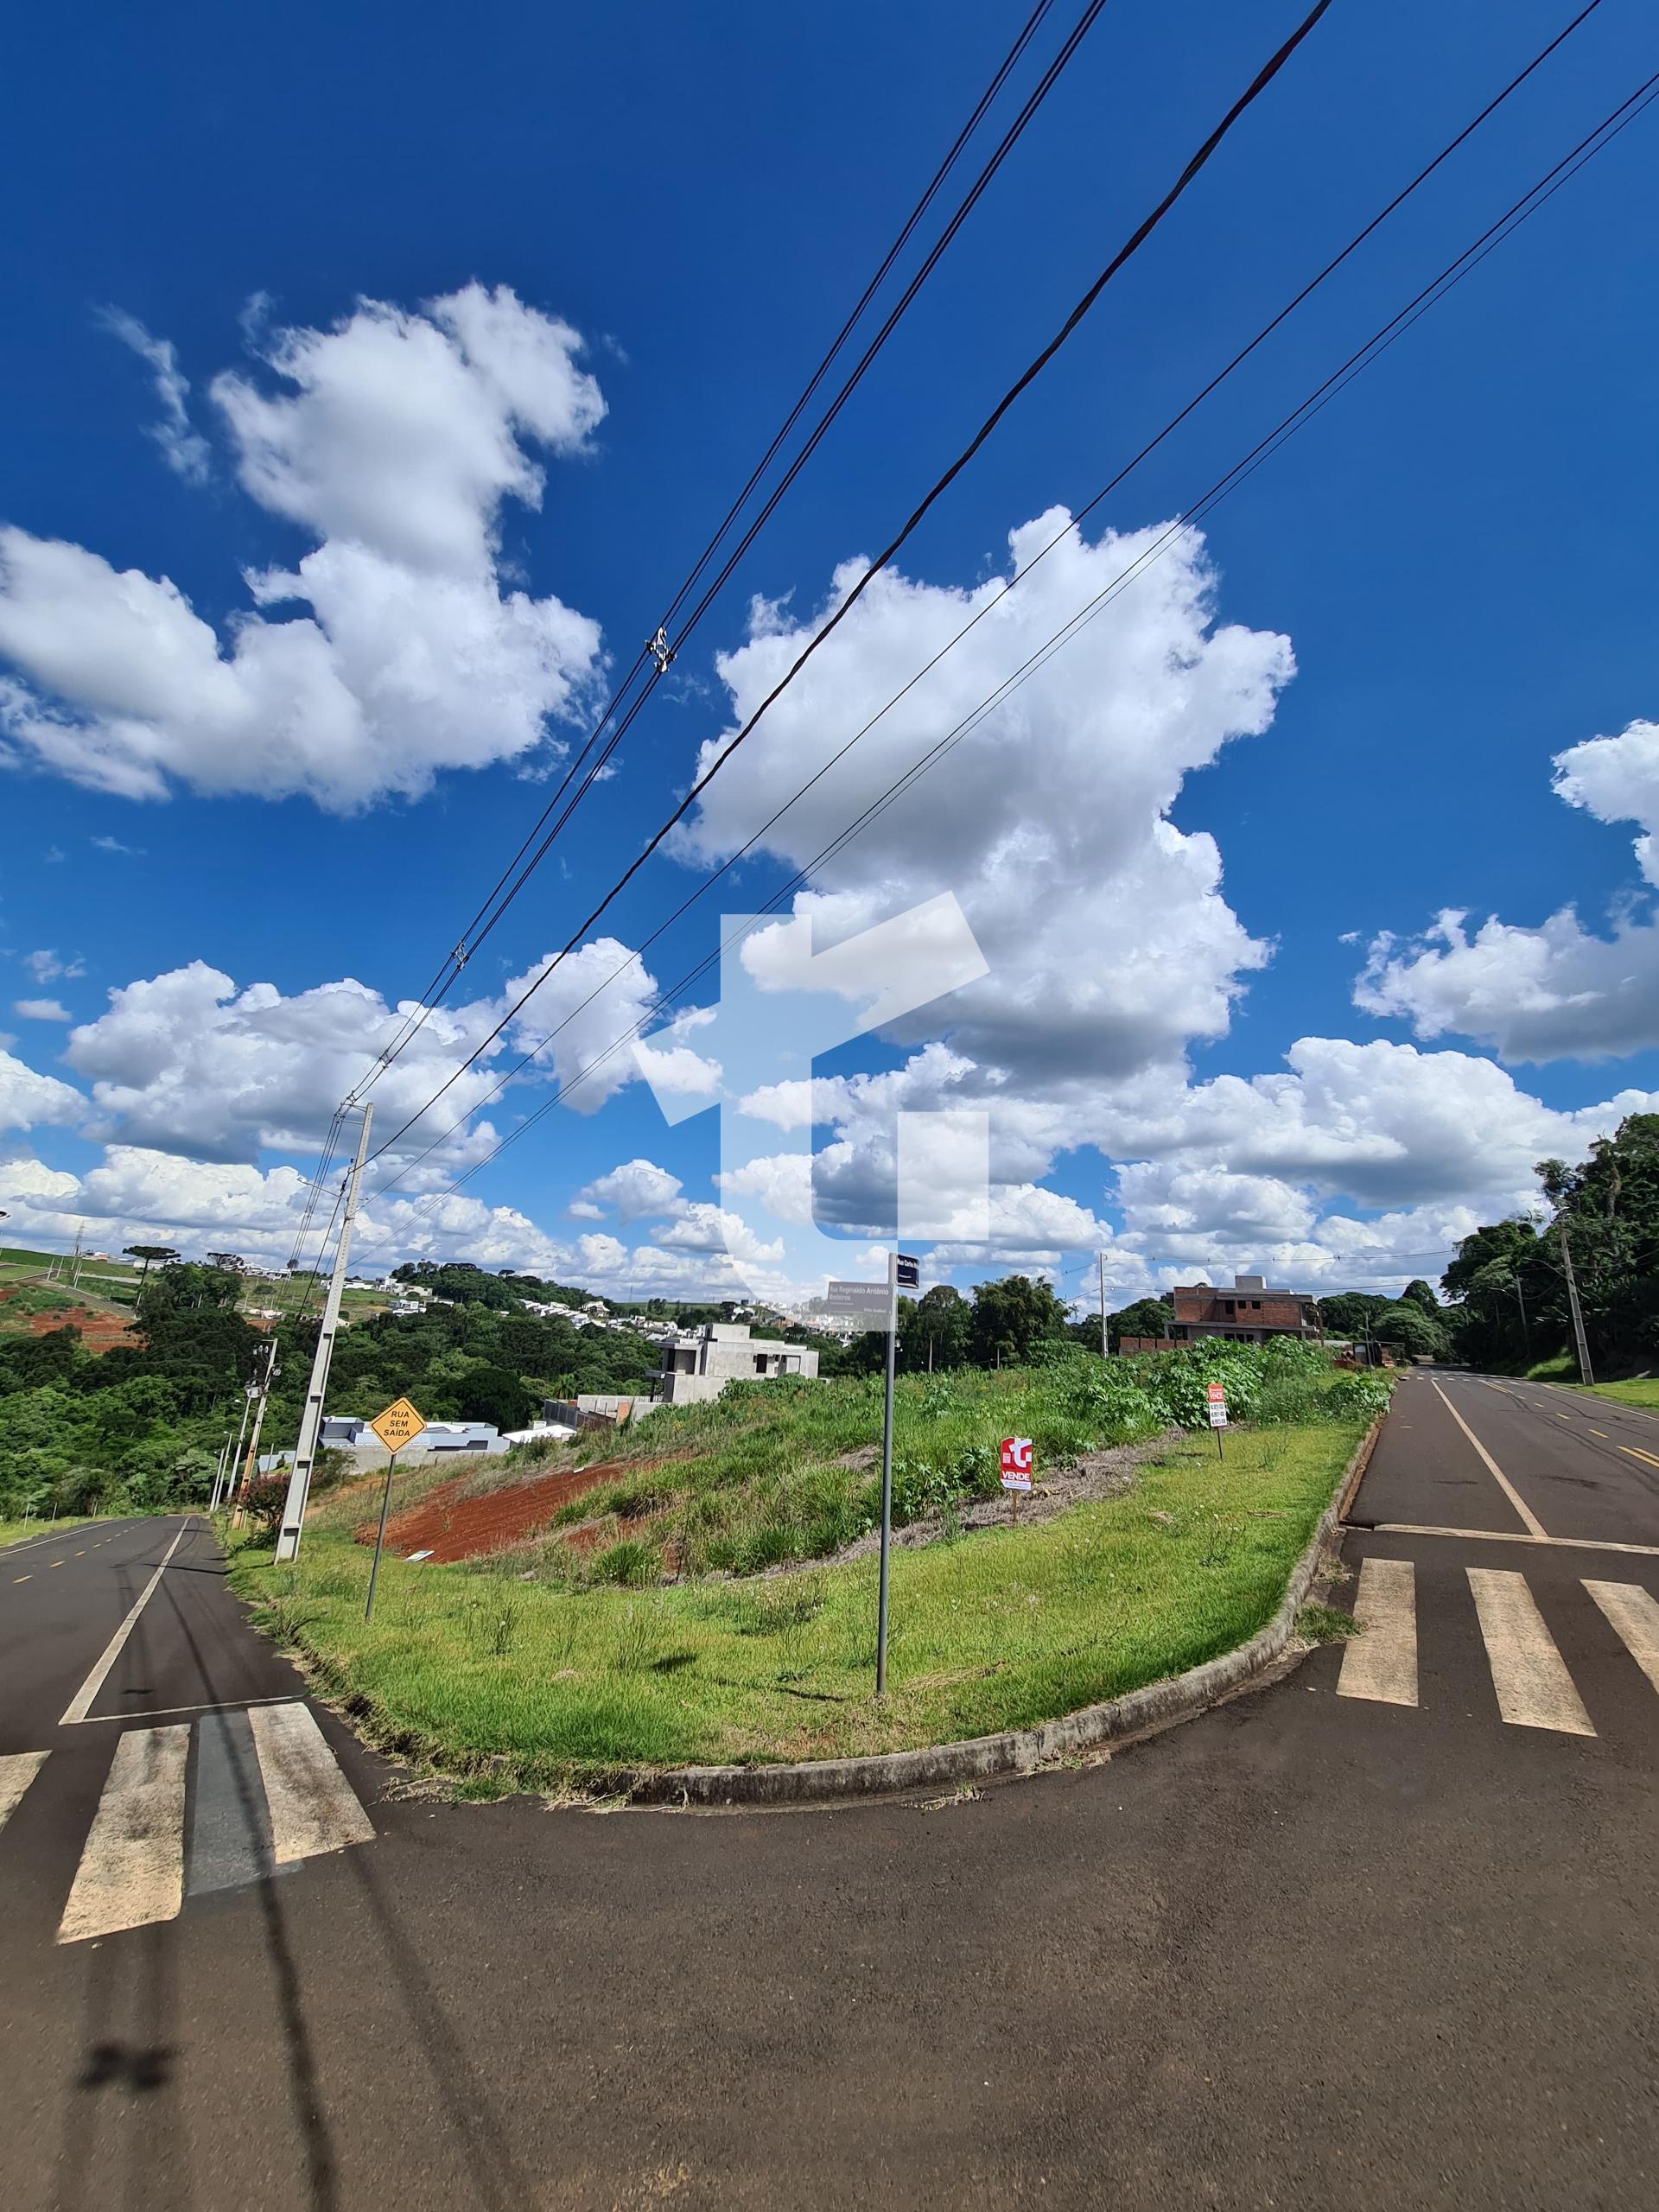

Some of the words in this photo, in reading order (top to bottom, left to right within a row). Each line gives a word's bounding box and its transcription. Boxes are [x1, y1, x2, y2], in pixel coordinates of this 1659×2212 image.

[839, 1286, 865, 1294] Reginaldo
[867, 1287, 889, 1295] Antônio
[1001, 1471, 1030, 1480] VENDE
